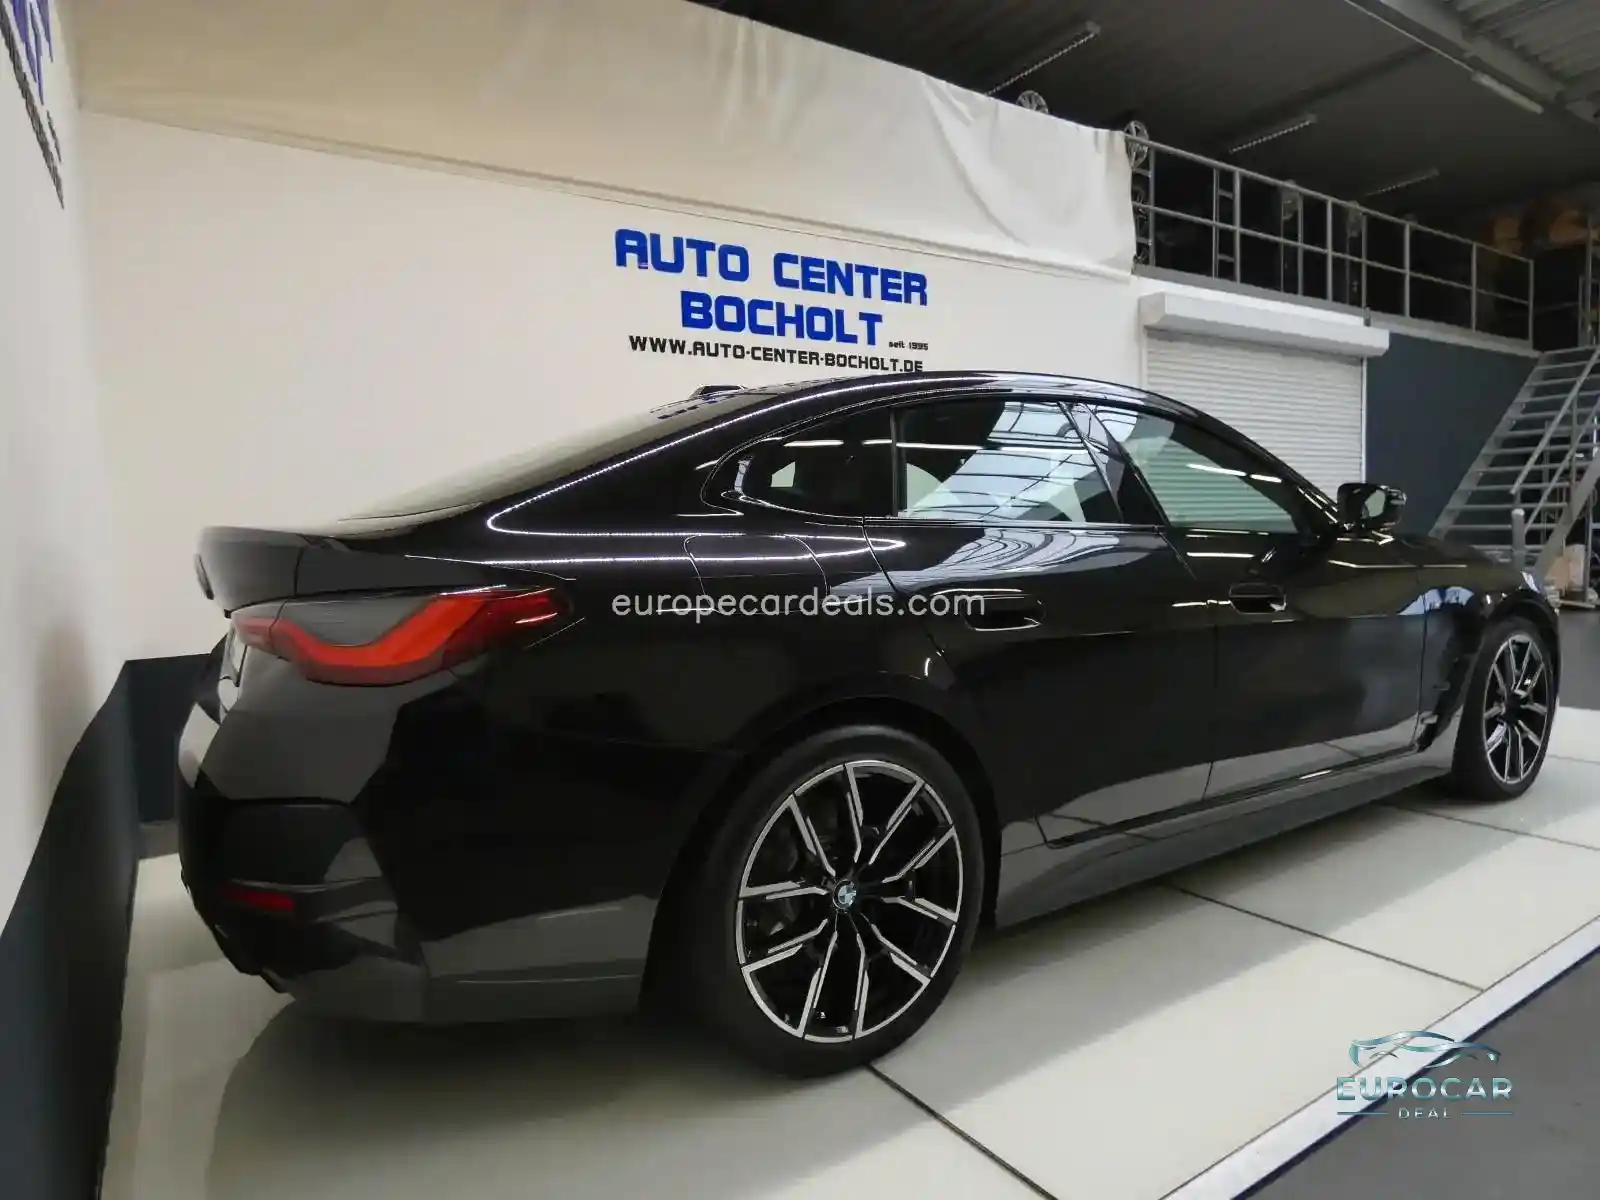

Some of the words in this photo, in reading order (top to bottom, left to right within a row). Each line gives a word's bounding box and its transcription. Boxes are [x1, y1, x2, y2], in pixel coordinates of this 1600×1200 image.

[615, 229, 749, 282] AUTO
[773, 252, 928, 306] CENTER
[680, 290, 883, 346] BOCHOLT
[888, 340, 905, 349] seit
